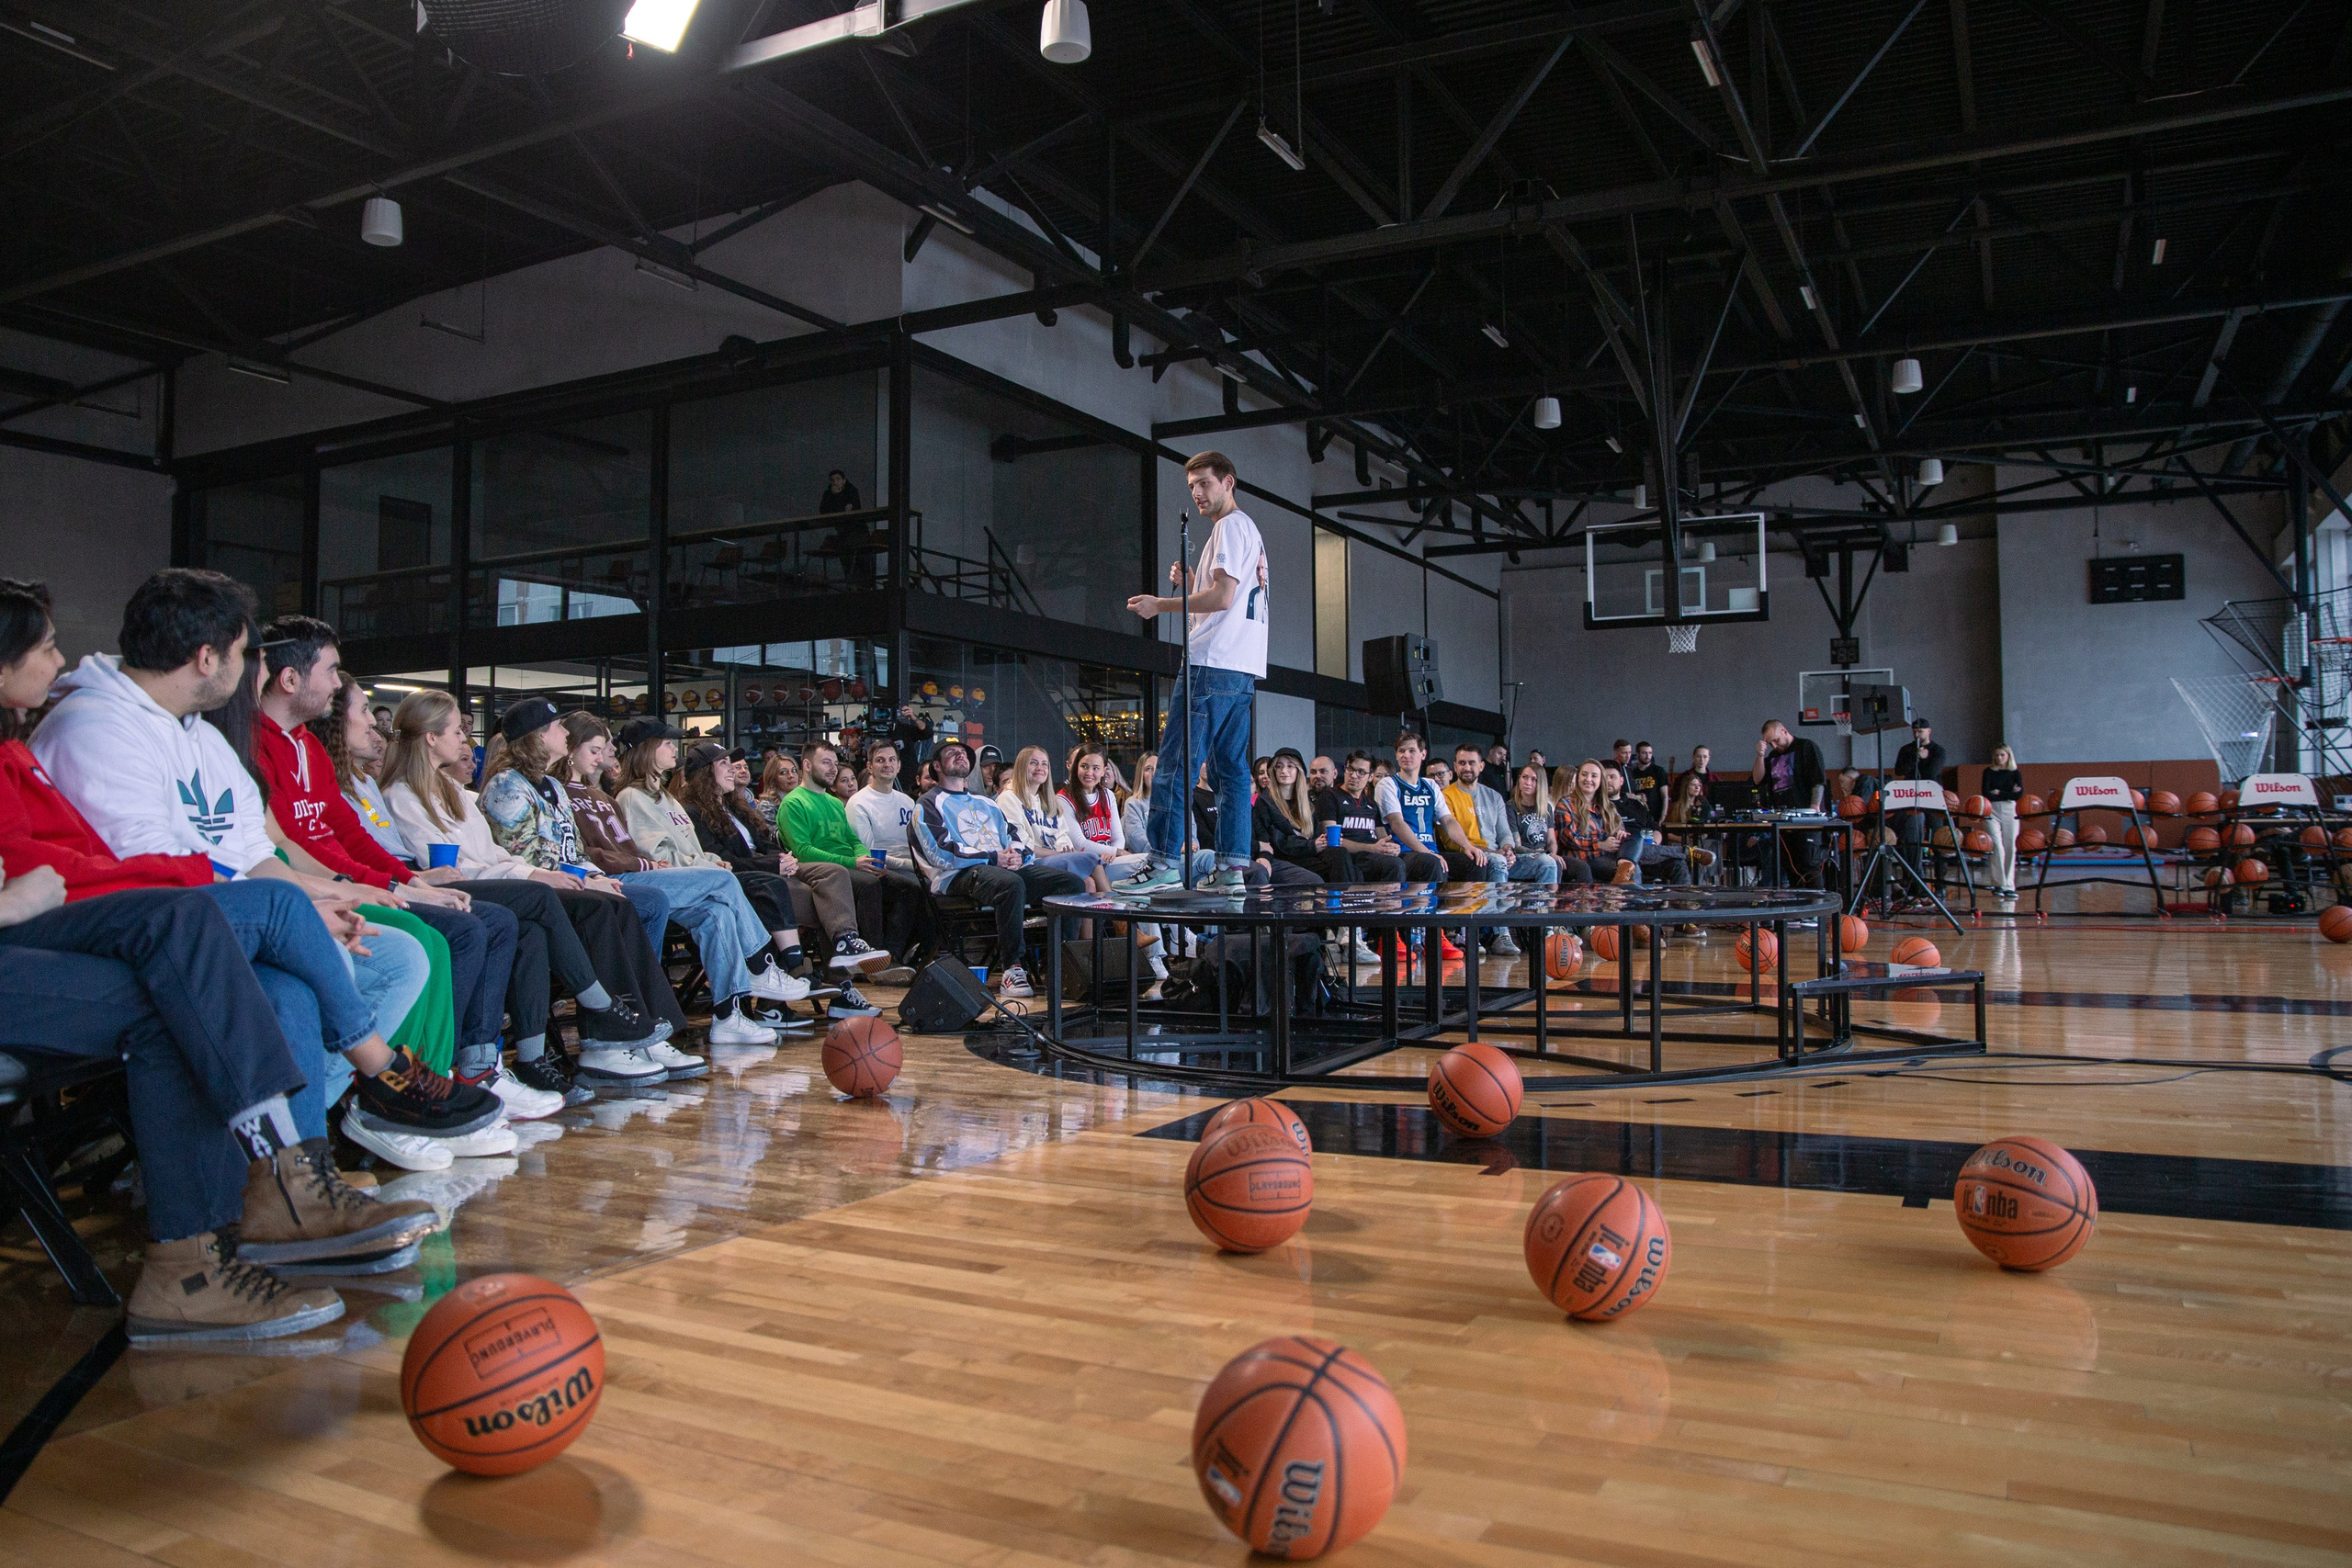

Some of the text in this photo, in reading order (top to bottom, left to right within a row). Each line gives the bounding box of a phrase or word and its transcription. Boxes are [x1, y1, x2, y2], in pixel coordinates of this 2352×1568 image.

[1403, 795, 1431, 807] EAST
[1892, 788, 1933, 799] Wilson
[2075, 786, 2119, 796] Wilson
[2255, 783, 2301, 793] Wilson
[585, 813, 632, 845] 71
[1080, 817, 1112, 840] BULL
[1342, 816, 1376, 829] MIAMI
[1415, 807, 1425, 833] 1
[1559, 938, 1568, 967] Wilson
[1433, 1079, 1479, 1131] Wilson
[1966, 1149, 2047, 1186] Wilson
[1986, 1190, 2018, 1220] nba
[1599, 1223, 1630, 1249] jr.
[1572, 1258, 1607, 1293] nba
[1601, 1235, 1665, 1316] Wilson
[463, 1366, 594, 1438] Wilson
